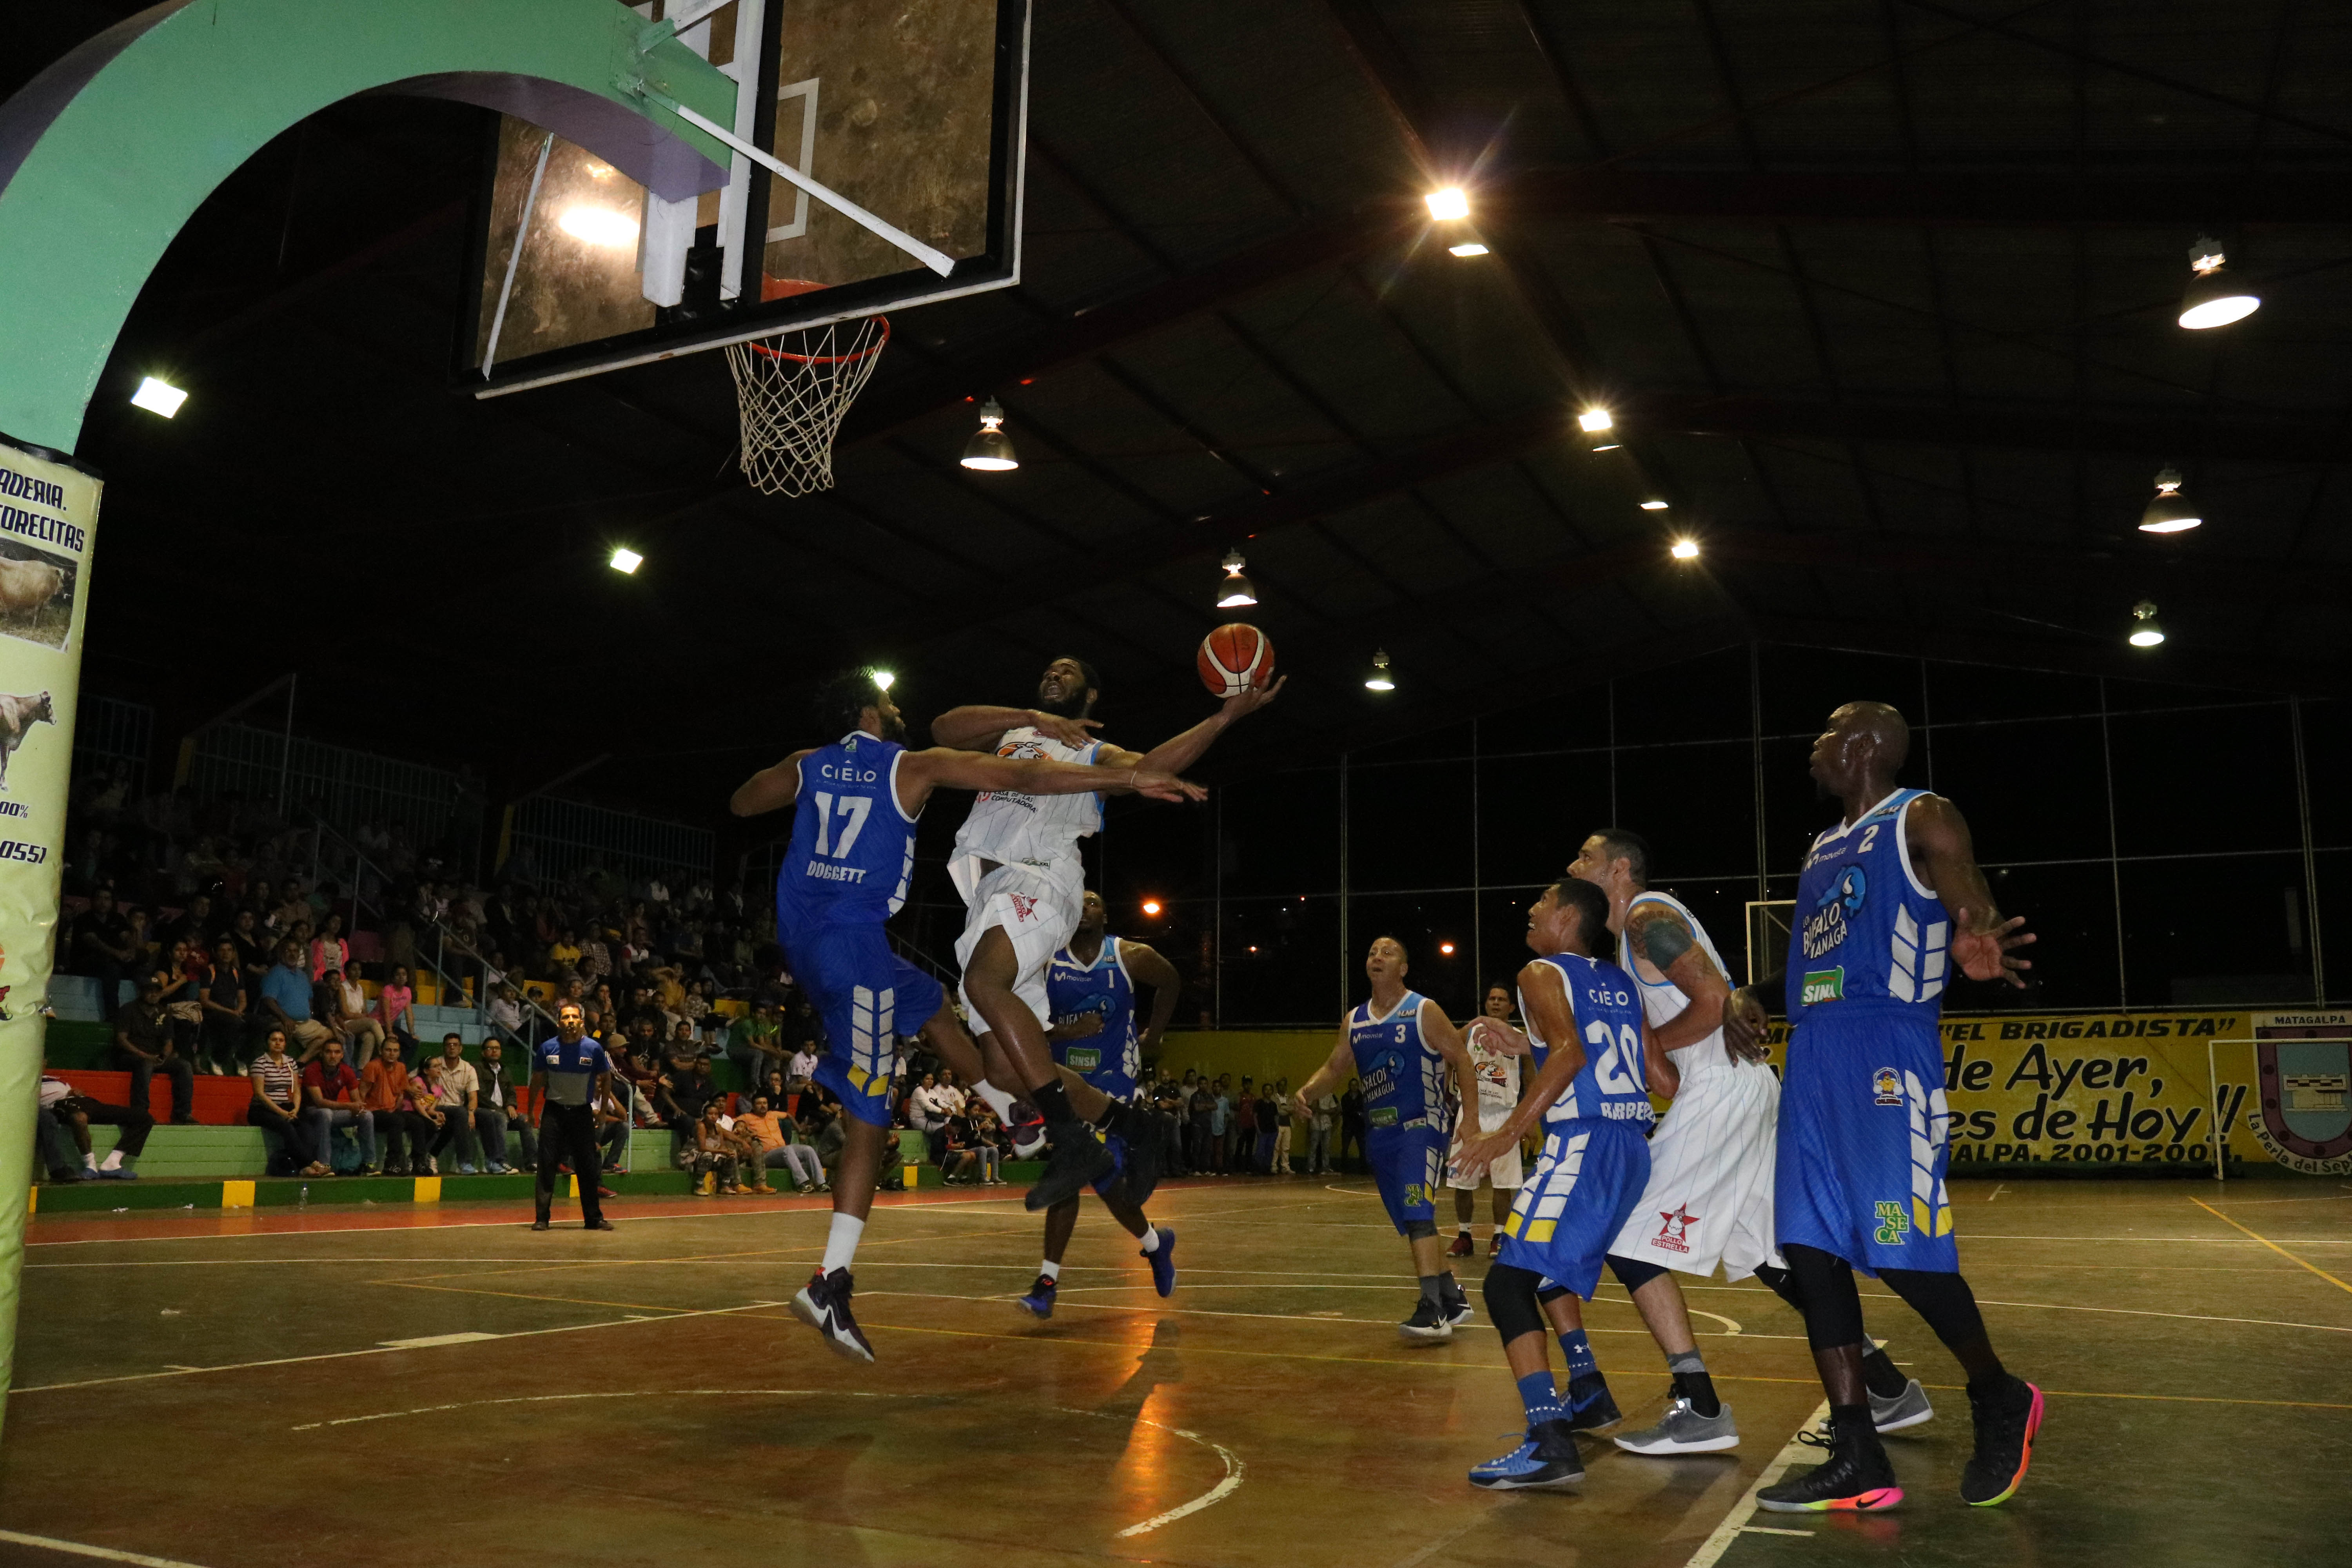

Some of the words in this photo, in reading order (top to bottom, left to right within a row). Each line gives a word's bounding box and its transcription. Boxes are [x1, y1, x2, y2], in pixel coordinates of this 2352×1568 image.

[0, 505, 84, 552] ORECITAS
[822, 764, 877, 782] CIELO
[815, 791, 872, 859] 17
[1857, 824, 1880, 854] 2
[806, 861, 866, 884] DOGGETT
[1108, 970, 1114, 988] 1
[2275, 1015, 2346, 1024] MATAGALPA
[1394, 1024, 1406, 1044] 3
[1069, 1055, 1096, 1067] SINSA
[1585, 1020, 1646, 1094] 20
[2005, 1043, 2163, 1100] Ayer,
[1367, 1081, 1395, 1103] MANAGUA
[2013, 1093, 2077, 1140] de
[2248, 1114, 2261, 1130] La
[2256, 1131, 2290, 1164] Perla
[2294, 1158, 2317, 1173] del
[1652, 1239, 1688, 1253] ESTRELLA
[1662, 1236, 1682, 1245] POLLO
